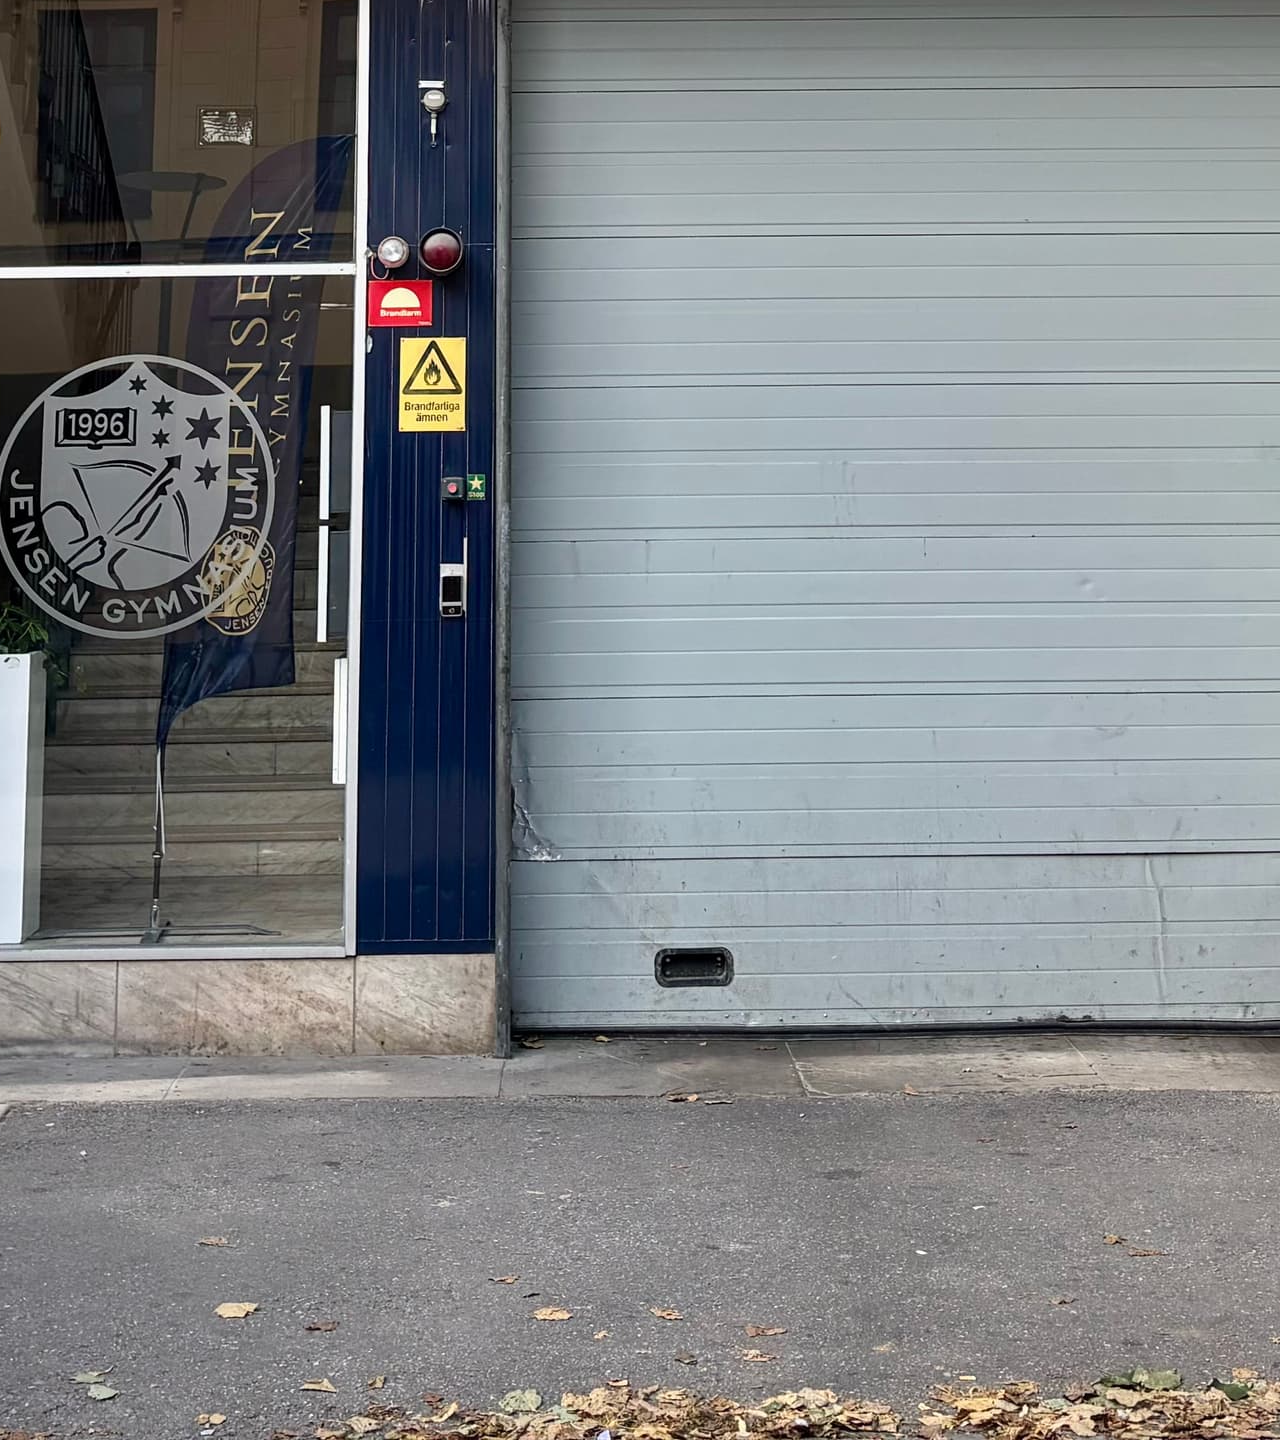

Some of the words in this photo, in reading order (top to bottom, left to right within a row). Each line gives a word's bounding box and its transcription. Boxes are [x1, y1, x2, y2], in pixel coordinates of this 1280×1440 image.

[223, 208, 286, 490] ENSEN
[266, 226, 313, 479] YMNASIM
[68, 412, 125, 437] 1996
[404, 401, 460, 413] Brandfarliga
[415, 412, 448, 422] ämnen
[9, 469, 90, 613] JENSEN
[102, 467, 259, 624] GYMNASIUM
